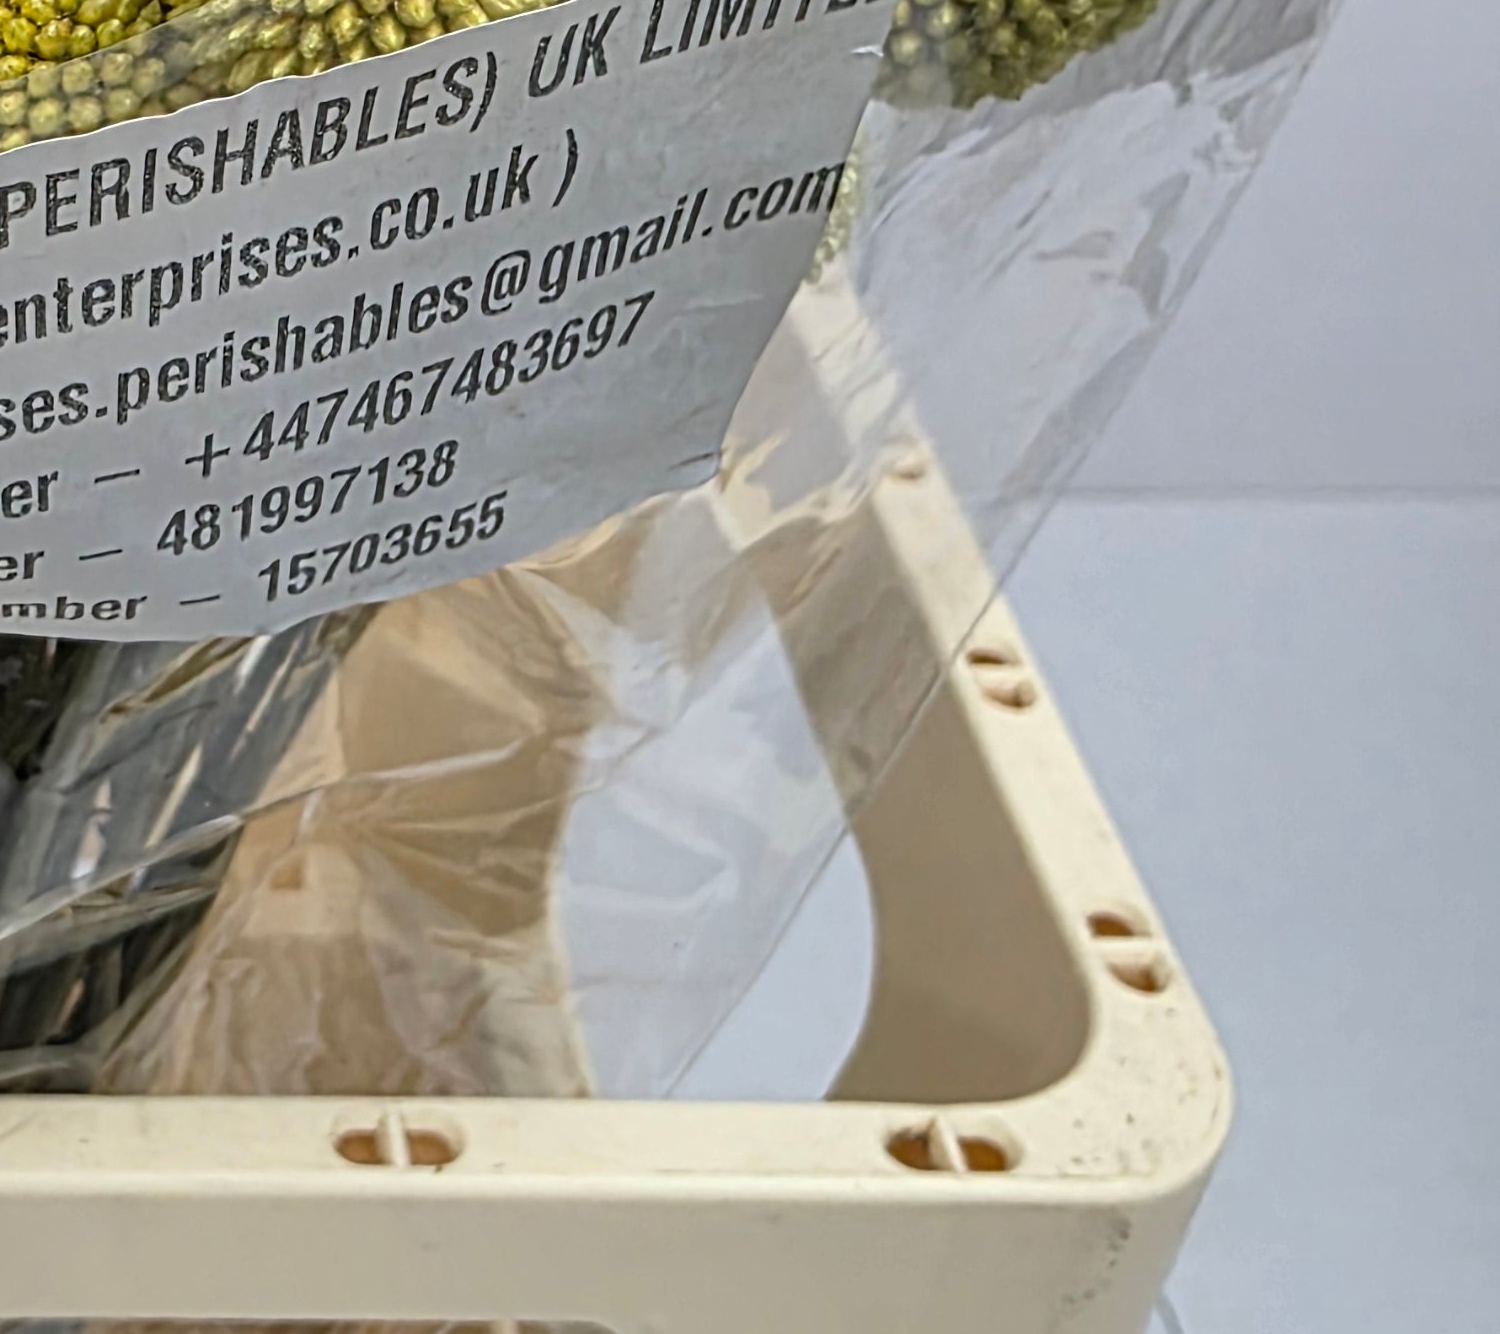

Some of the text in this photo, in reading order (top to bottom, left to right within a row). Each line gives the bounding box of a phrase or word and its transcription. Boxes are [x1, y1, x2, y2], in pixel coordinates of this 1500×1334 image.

[528, 6, 621, 97] UK
[184, 291, 654, 477] +447467483697
[157, 440, 456, 556] 481997138
[257, 493, 506, 603] 15703655
